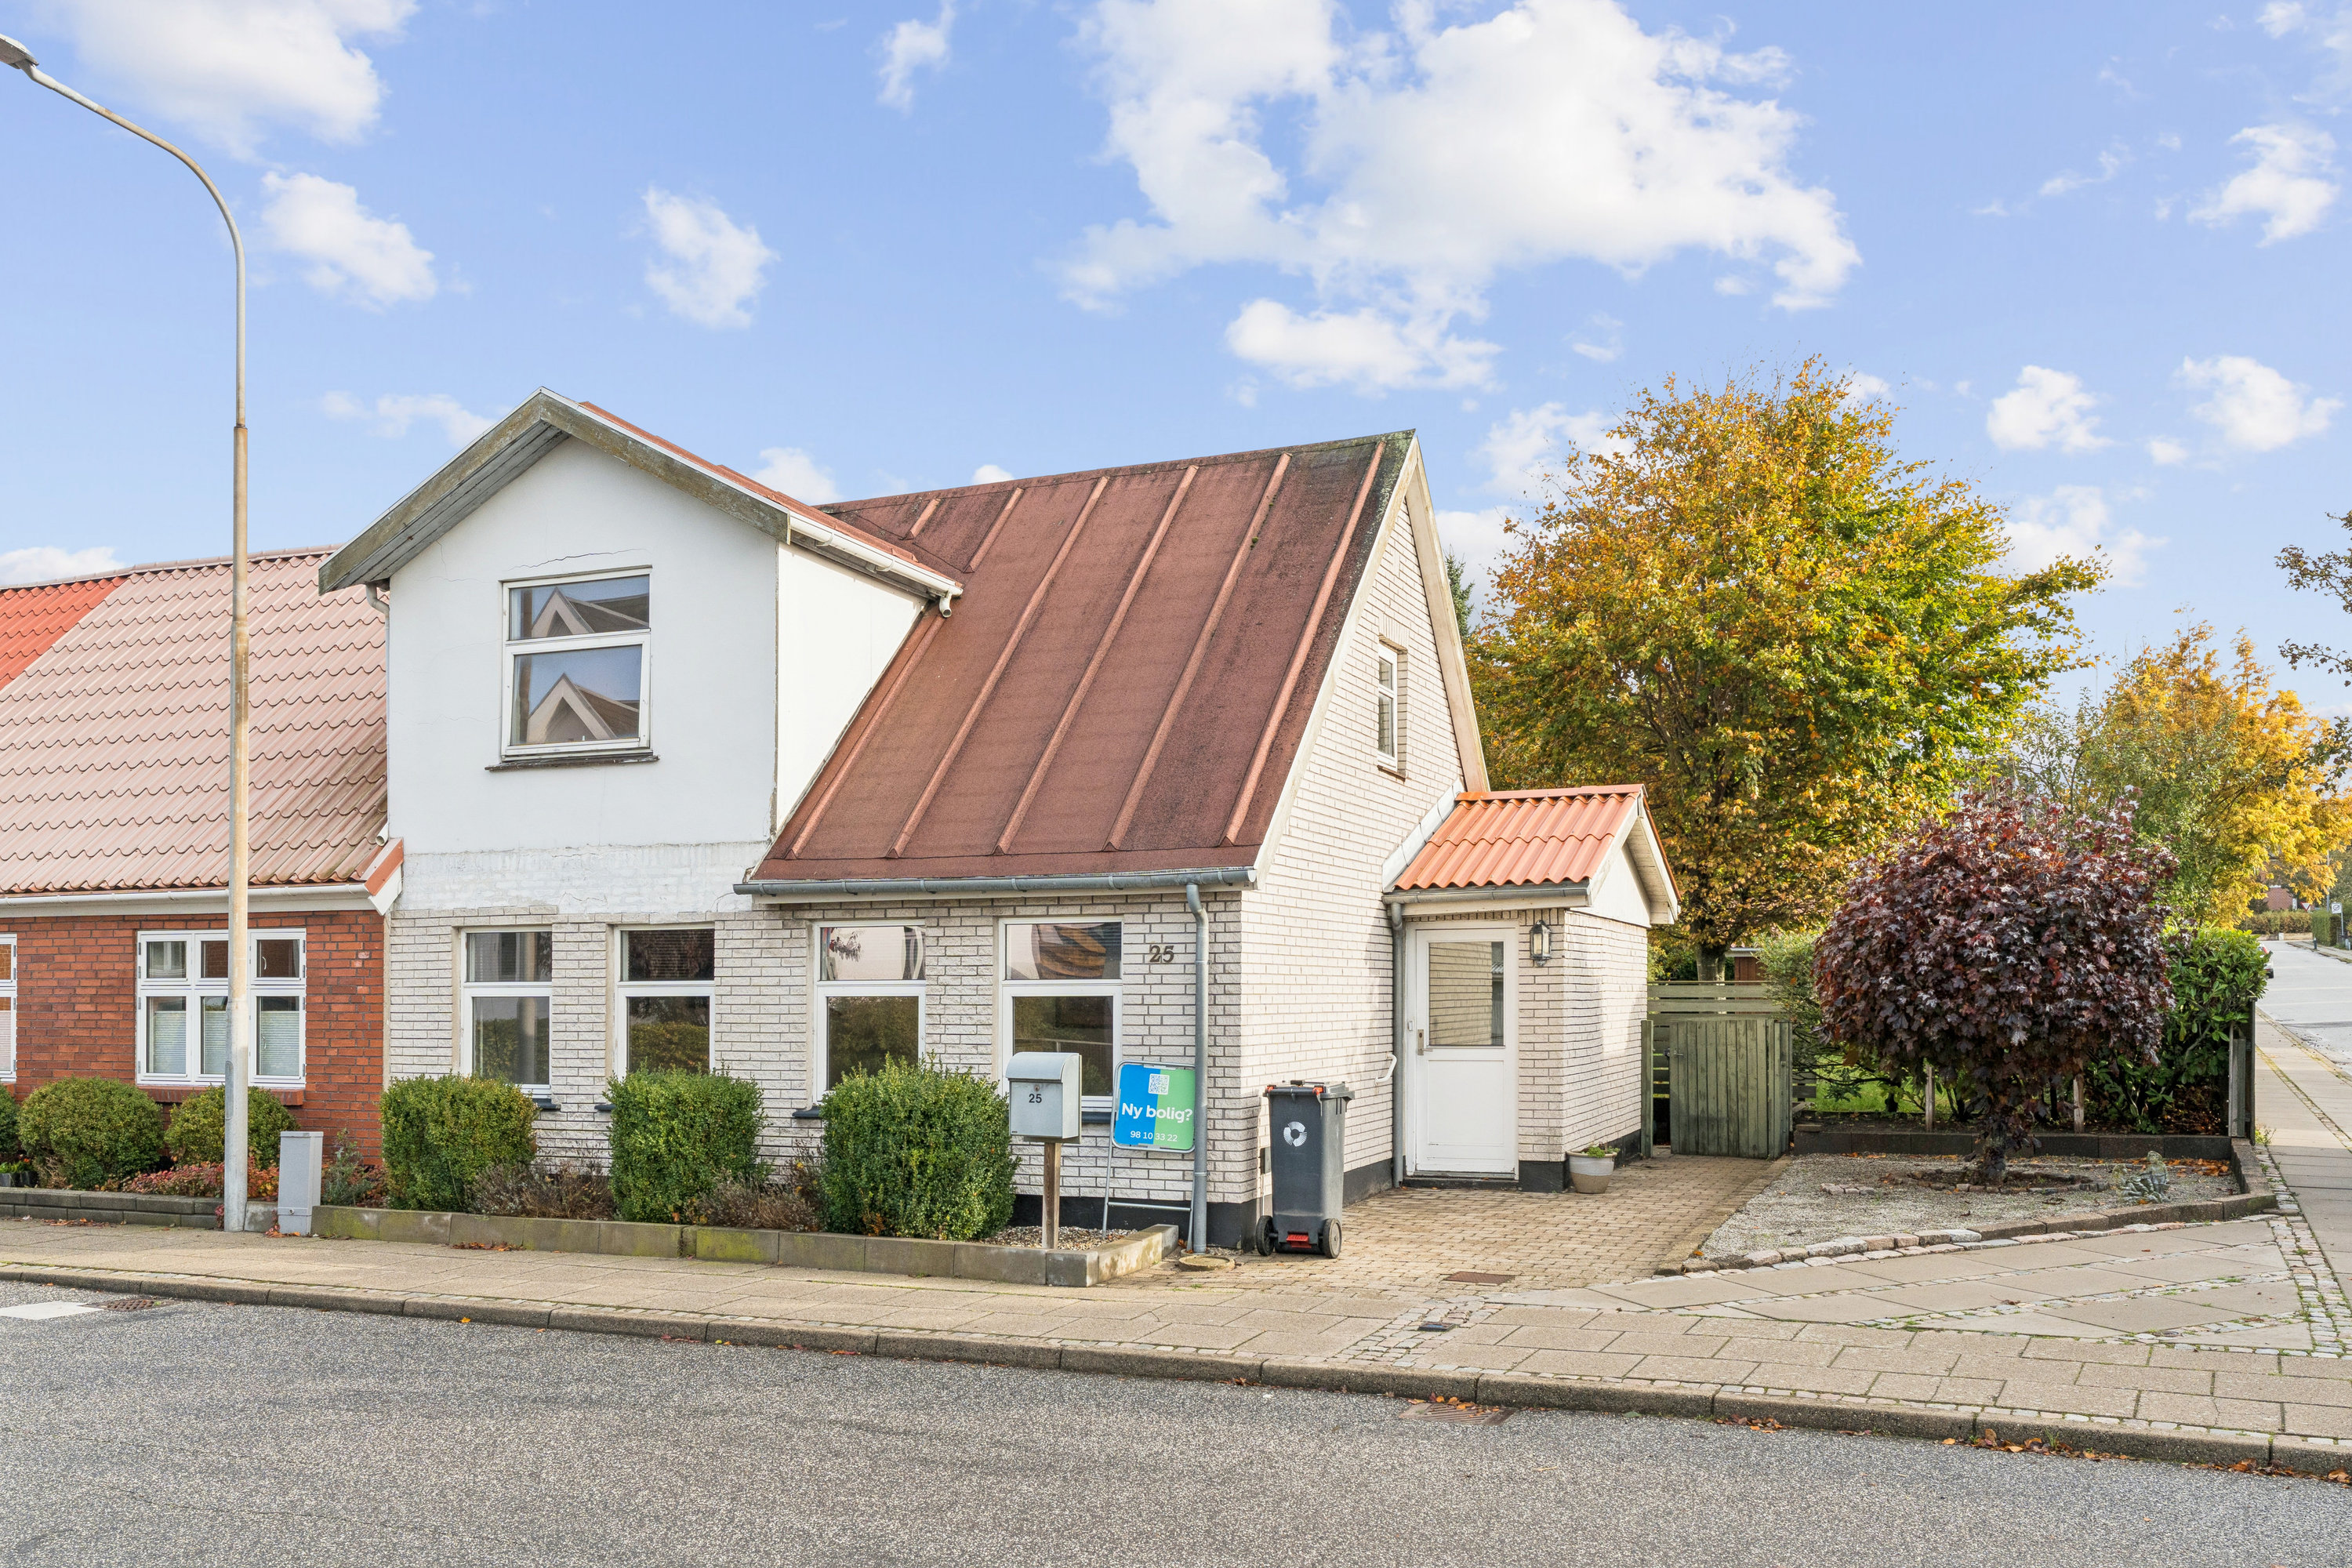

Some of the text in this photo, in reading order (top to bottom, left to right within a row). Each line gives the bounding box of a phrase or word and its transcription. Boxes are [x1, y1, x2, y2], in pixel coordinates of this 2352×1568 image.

[1149, 945, 1174, 963] 25
[1029, 1093, 1043, 1103] 25
[1121, 1102, 1193, 1123] Ny bolig?
[1130, 1130, 1142, 1138] 98
[1143, 1131, 1153, 1140] 10
[1167, 1134, 1178, 1142] 22
